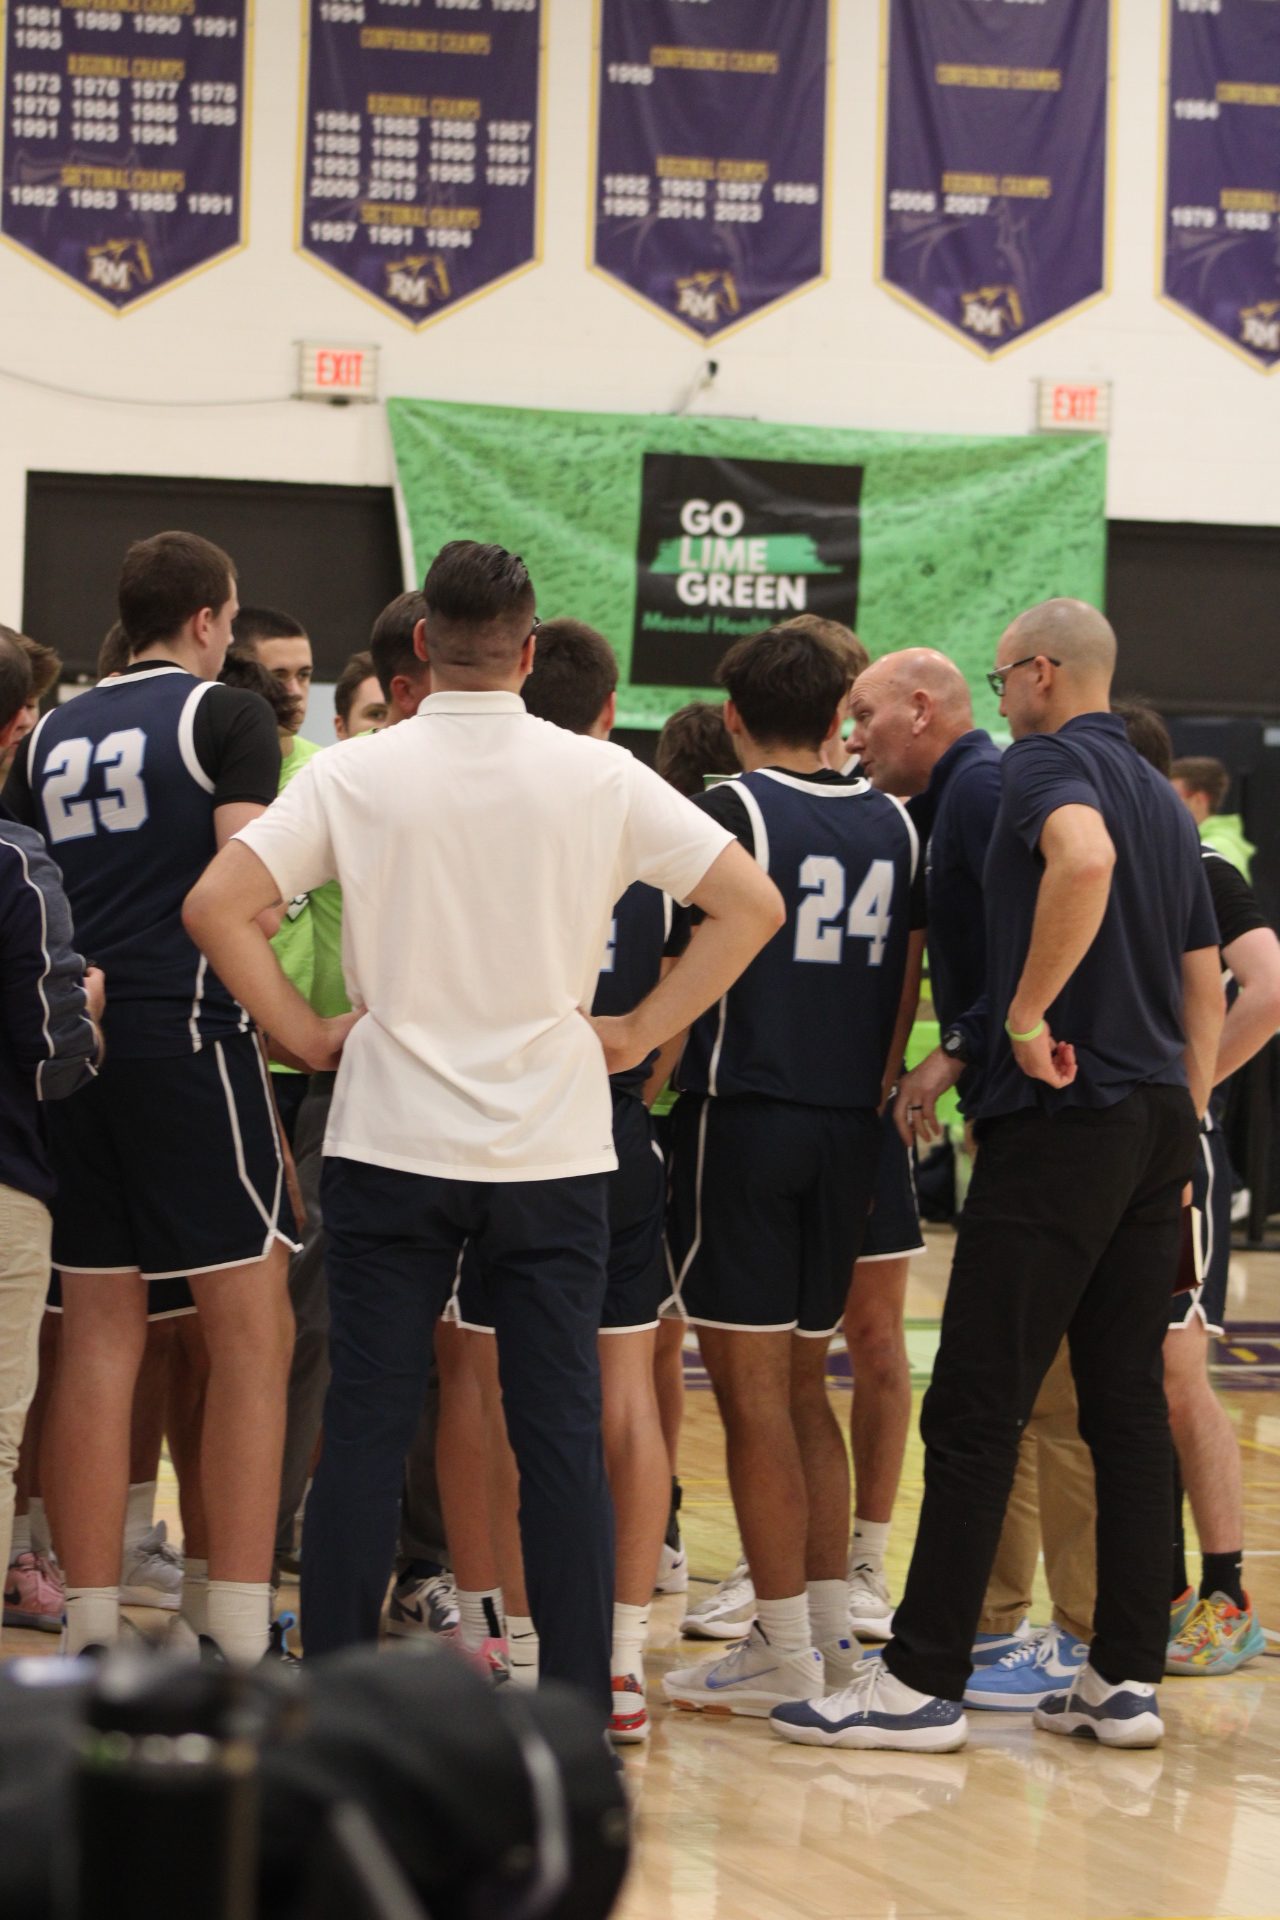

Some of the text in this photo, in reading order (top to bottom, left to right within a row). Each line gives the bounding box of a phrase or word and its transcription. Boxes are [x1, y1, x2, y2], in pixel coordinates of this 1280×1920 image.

[193, 17, 237, 37] 1991
[13, 73, 237, 104] 1973 1976 1977 1978
[12, 96, 60, 116] 1979
[12, 118, 58, 139] 1991
[487, 144, 530, 164] 1991
[486, 166, 531, 186] 1997
[10, 186, 58, 207] 1982
[188, 195, 233, 215] 1991
[368, 180, 417, 201] 2019
[716, 181, 763, 201] 1997
[311, 222, 472, 248] 1987 1991 1994
[316, 350, 364, 387] EXIT
[1052, 385, 1099, 423] EXIT
[680, 498, 744, 537] GO
[679, 535, 768, 573] LIME
[676, 571, 808, 611] GREEN
[642, 611, 711, 635] Mental
[42, 727, 149, 845] 23
[793, 854, 895, 967] 24
